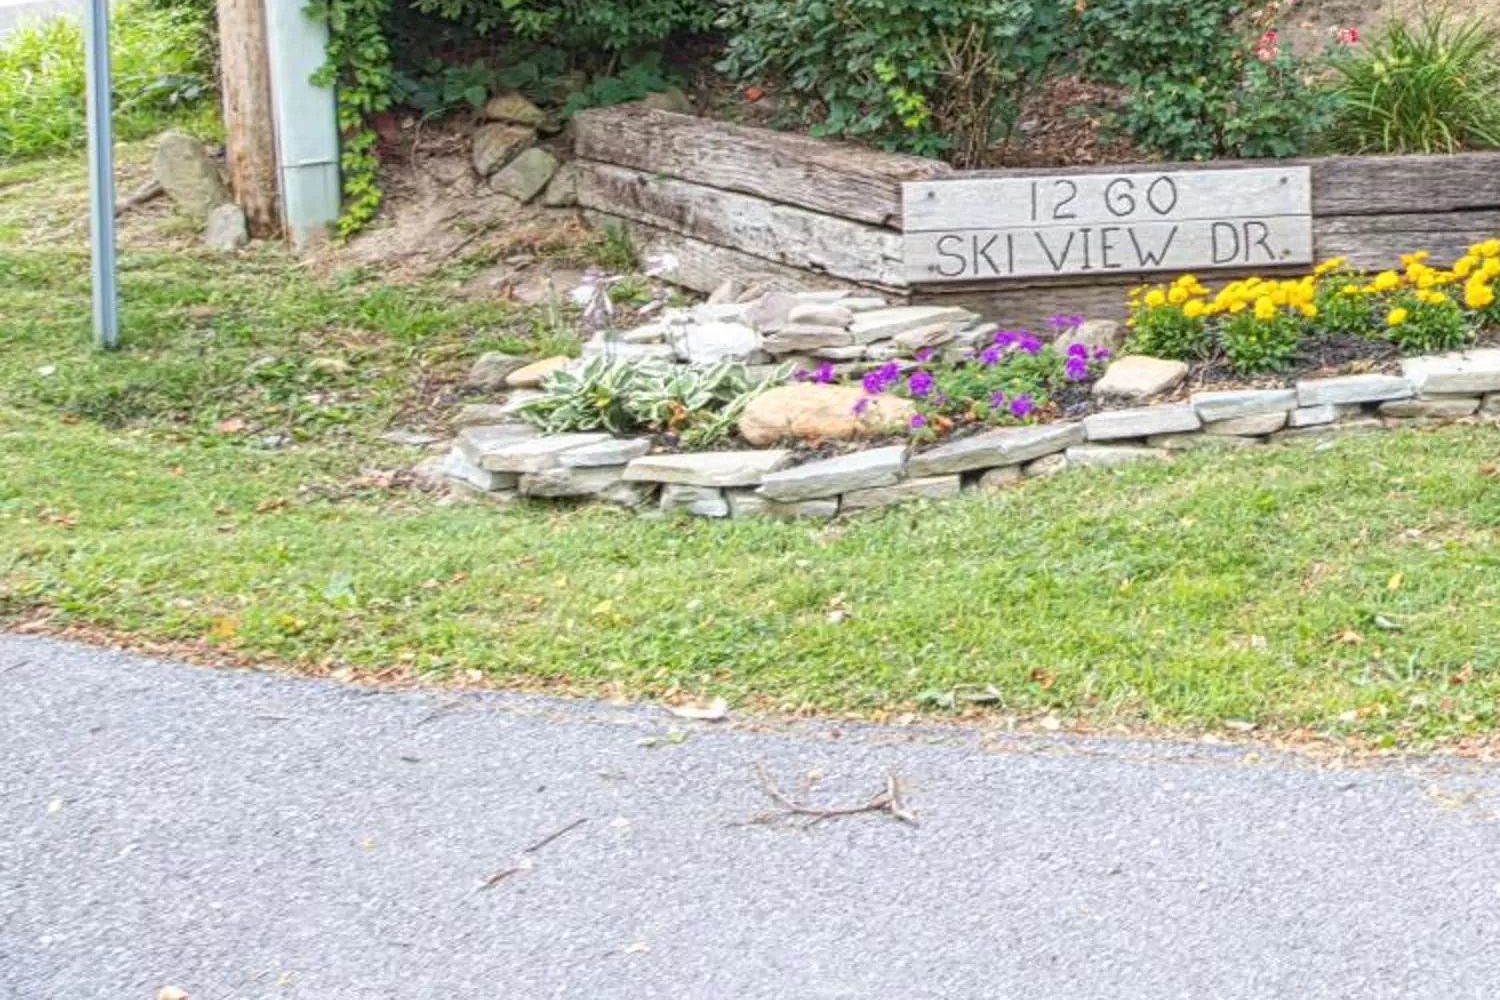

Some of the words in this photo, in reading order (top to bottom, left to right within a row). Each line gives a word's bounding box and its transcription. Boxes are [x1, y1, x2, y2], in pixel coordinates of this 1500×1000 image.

[1030, 175, 1179, 222] 1260
[935, 234, 1014, 277] SKI
[1035, 225, 1179, 271] VIEW
